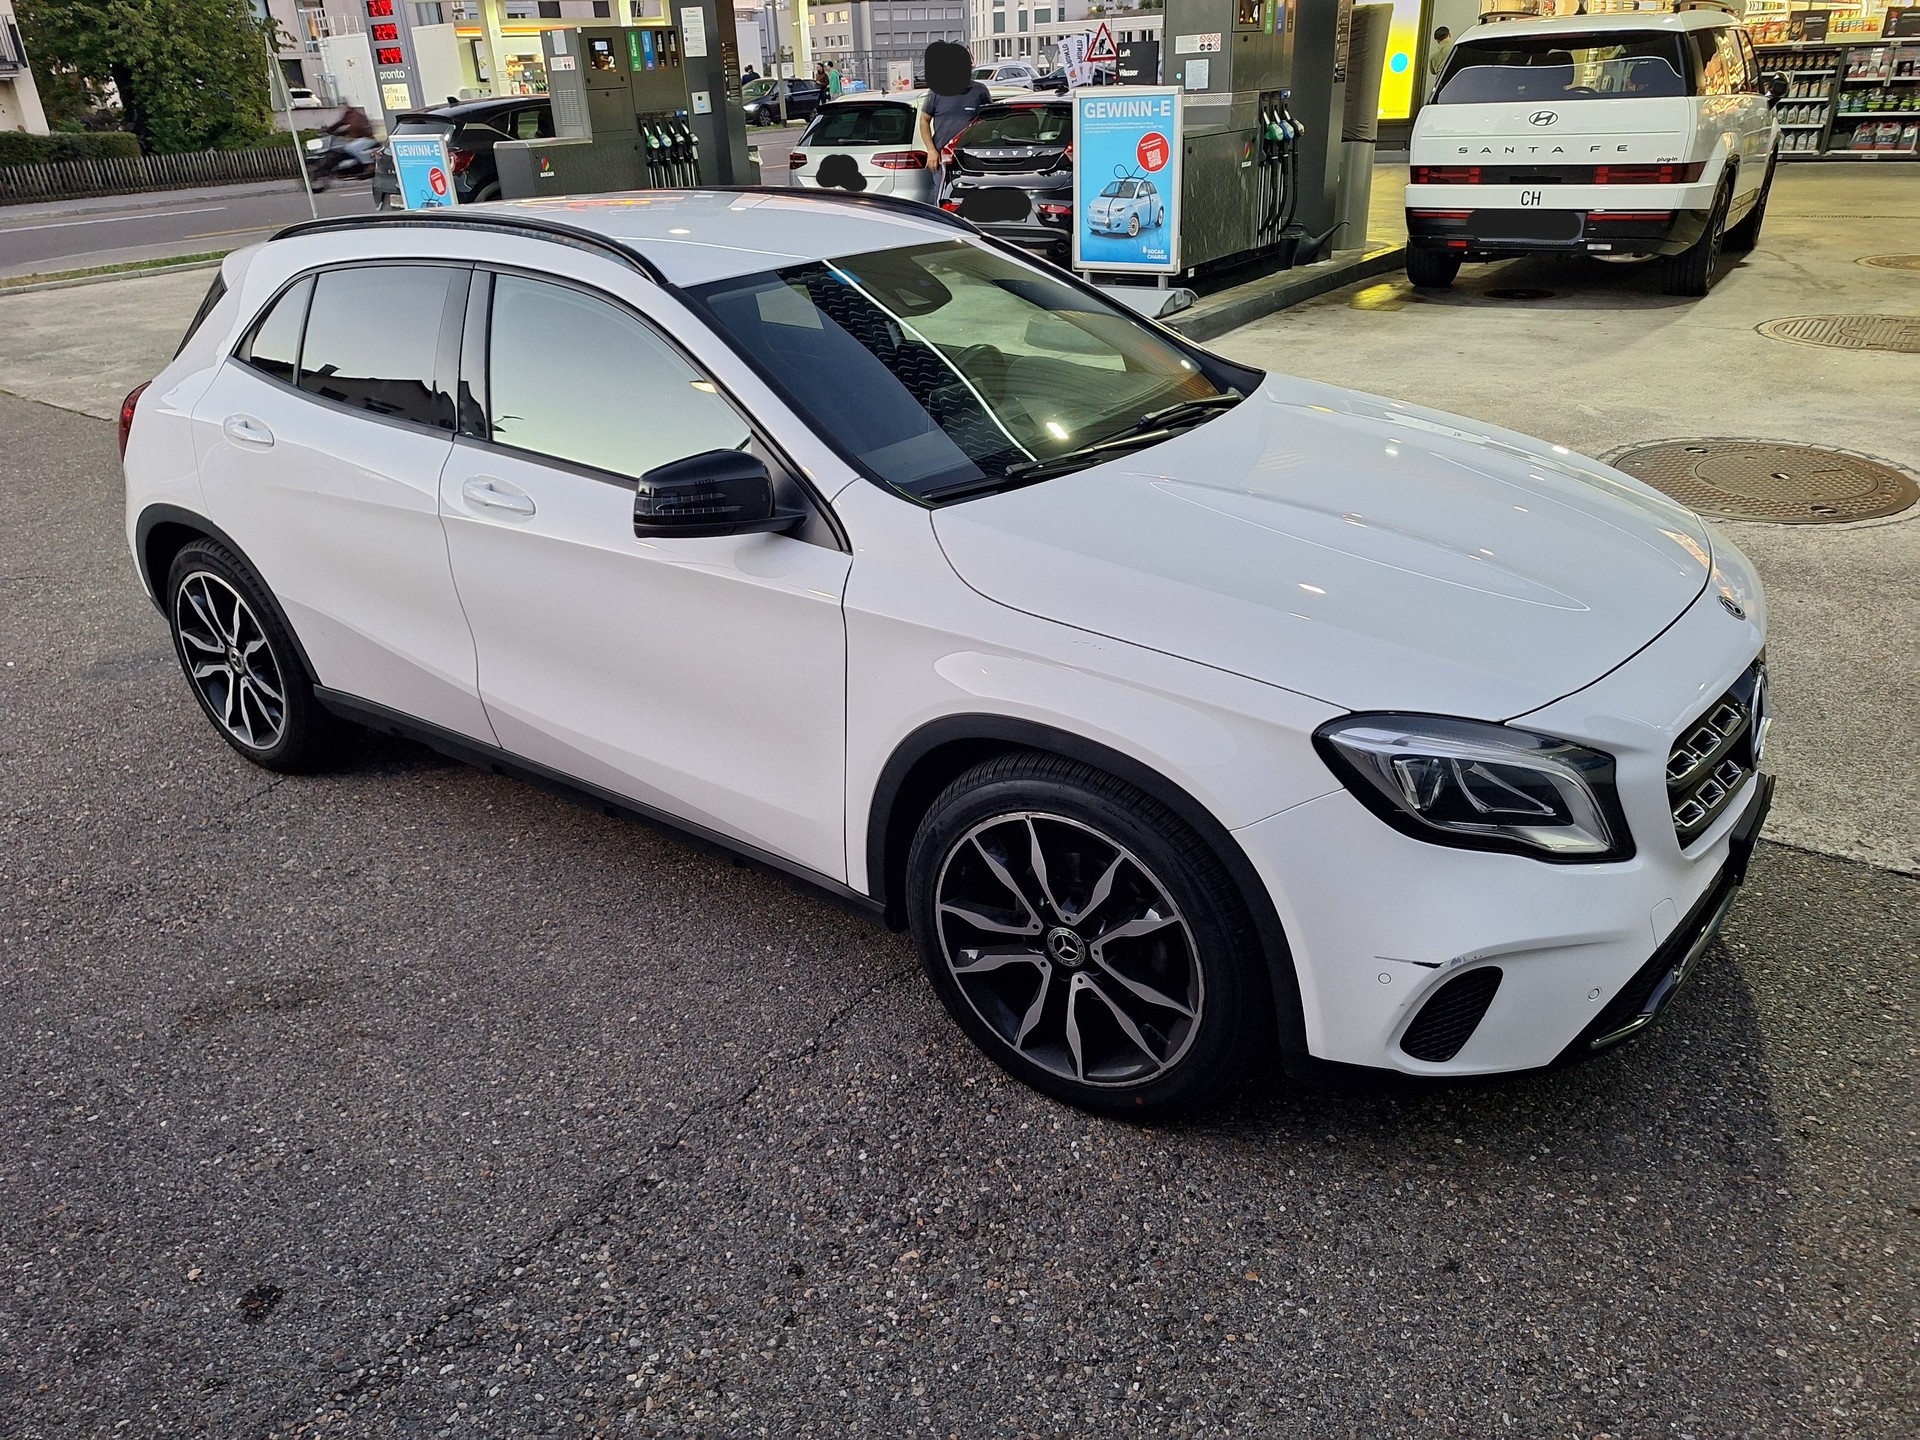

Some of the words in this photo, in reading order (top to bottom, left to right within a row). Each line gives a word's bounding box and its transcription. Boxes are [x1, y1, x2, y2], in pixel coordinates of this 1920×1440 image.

[1252, 4, 1259, 21] 4
[1119, 48, 1131, 57] Luft
[608, 55, 616, 68] 2
[380, 69, 405, 81] pronto
[1119, 68, 1139, 76] Wasser
[1084, 99, 1171, 119] GEWINN-E
[397, 144, 441, 157] GEWINN-E
[1458, 146, 1564, 154] SANTA
[1589, 144, 1629, 153] FE
[1520, 190, 1542, 206] CH
